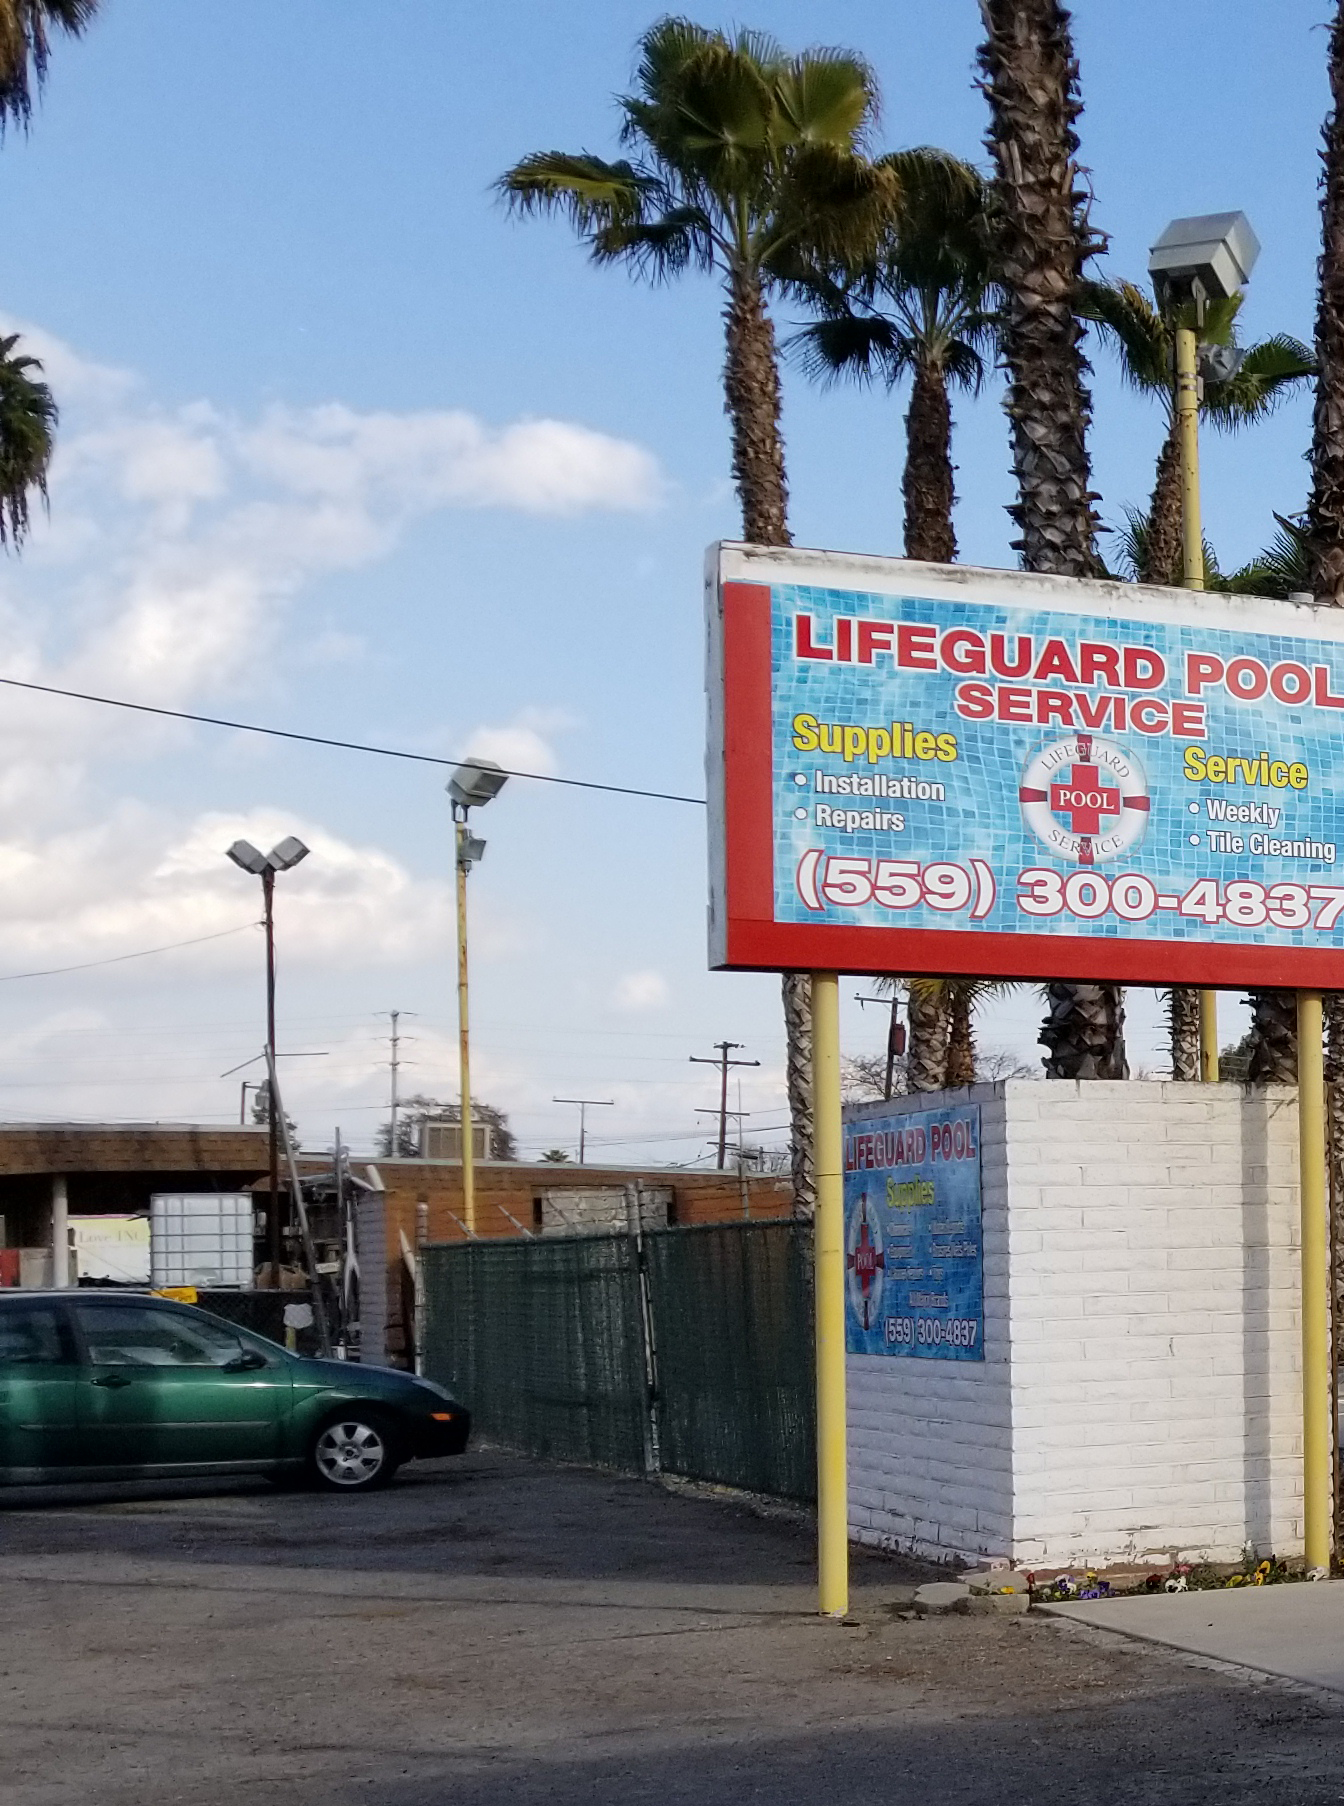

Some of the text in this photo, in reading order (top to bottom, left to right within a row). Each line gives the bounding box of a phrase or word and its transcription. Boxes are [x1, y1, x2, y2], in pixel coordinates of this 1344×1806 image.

[793, 613, 1166, 692] LIFEGUARD
[955, 682, 1207, 739] SERVICE
[792, 713, 958, 764] Supplies
[1041, 743, 1130, 778] LIFEGUARD
[1184, 747, 1308, 790] Service
[815, 771, 945, 804] Installation
[1058, 790, 1115, 810] POOL
[815, 804, 904, 834] Repairs
[1206, 799, 1280, 829] Weekly
[1048, 829, 1124, 857] SERVICE
[1206, 829, 1335, 864] Tile Cleaning
[798, 849, 995, 920] (559)
[844, 1119, 976, 1174] LIFEGUARD POOL
[886, 1173, 935, 1213] Supplies
[885, 1316, 978, 1349] (559) 300-4837
